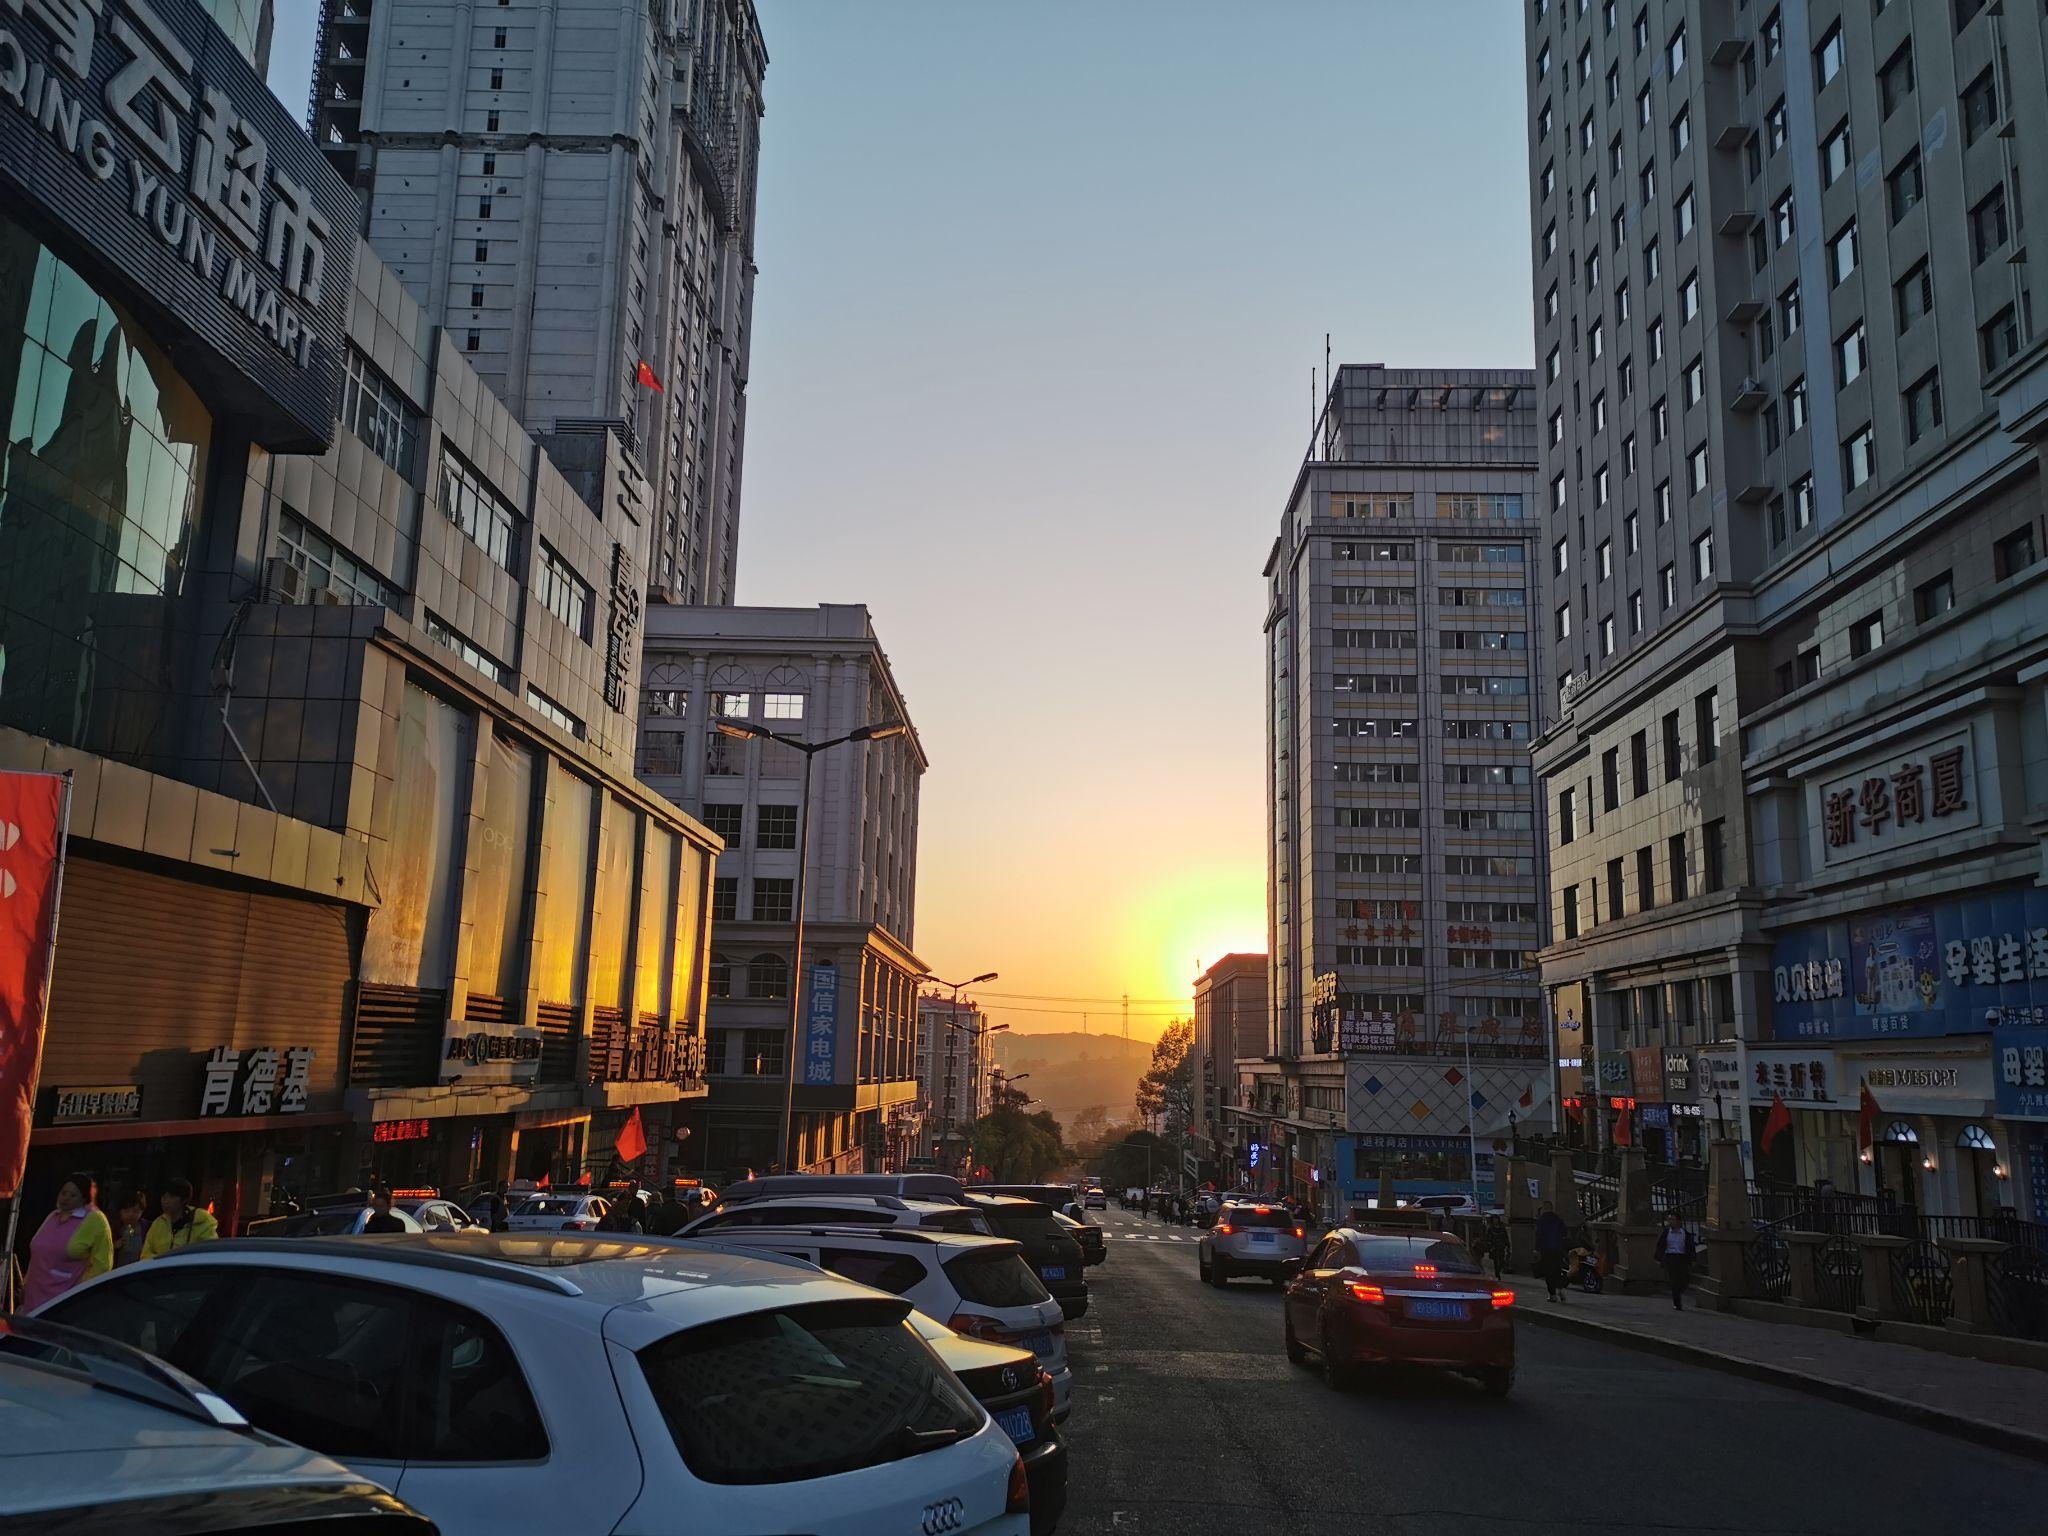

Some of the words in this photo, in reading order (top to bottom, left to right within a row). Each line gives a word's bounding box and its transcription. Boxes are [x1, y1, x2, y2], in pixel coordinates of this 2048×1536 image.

[129, 158, 216, 279] YUN
[222, 257, 317, 370] MART
[1826, 745, 1968, 848] 新华商厦
[807, 968, 837, 1082] 国信家电城
[199, 1045, 315, 1117] 肯德基
